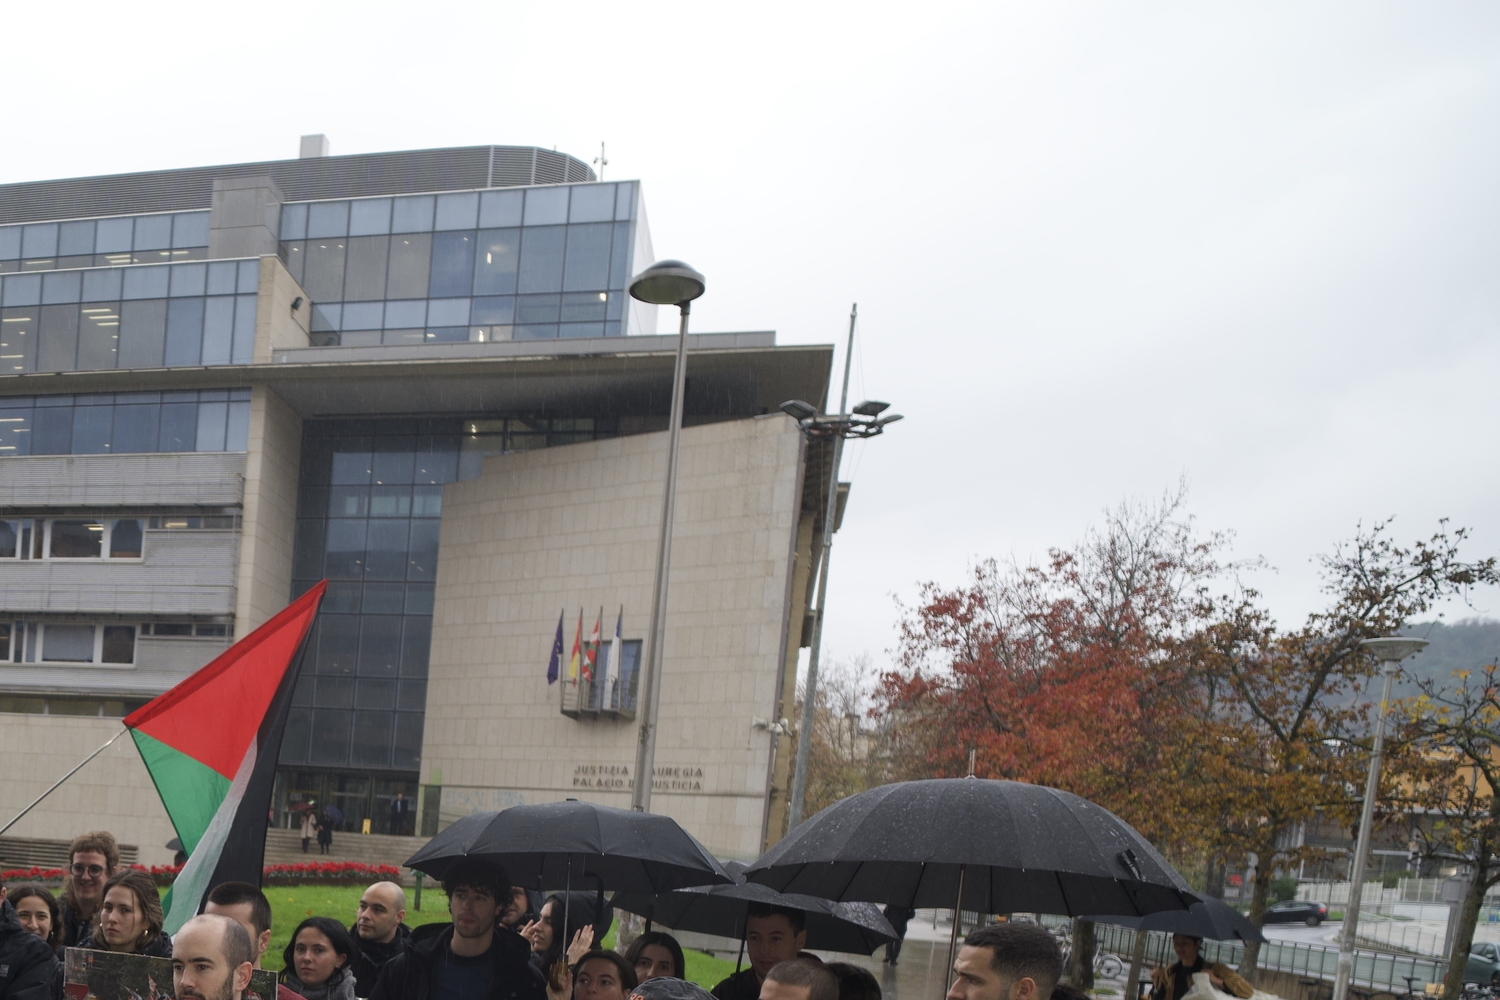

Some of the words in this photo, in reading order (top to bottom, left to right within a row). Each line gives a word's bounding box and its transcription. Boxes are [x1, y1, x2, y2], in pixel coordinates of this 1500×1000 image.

[574, 765, 629, 776] JUSTIZIA
[652, 766, 703, 778] AUREGIA
[573, 777, 623, 788] PALACIO
